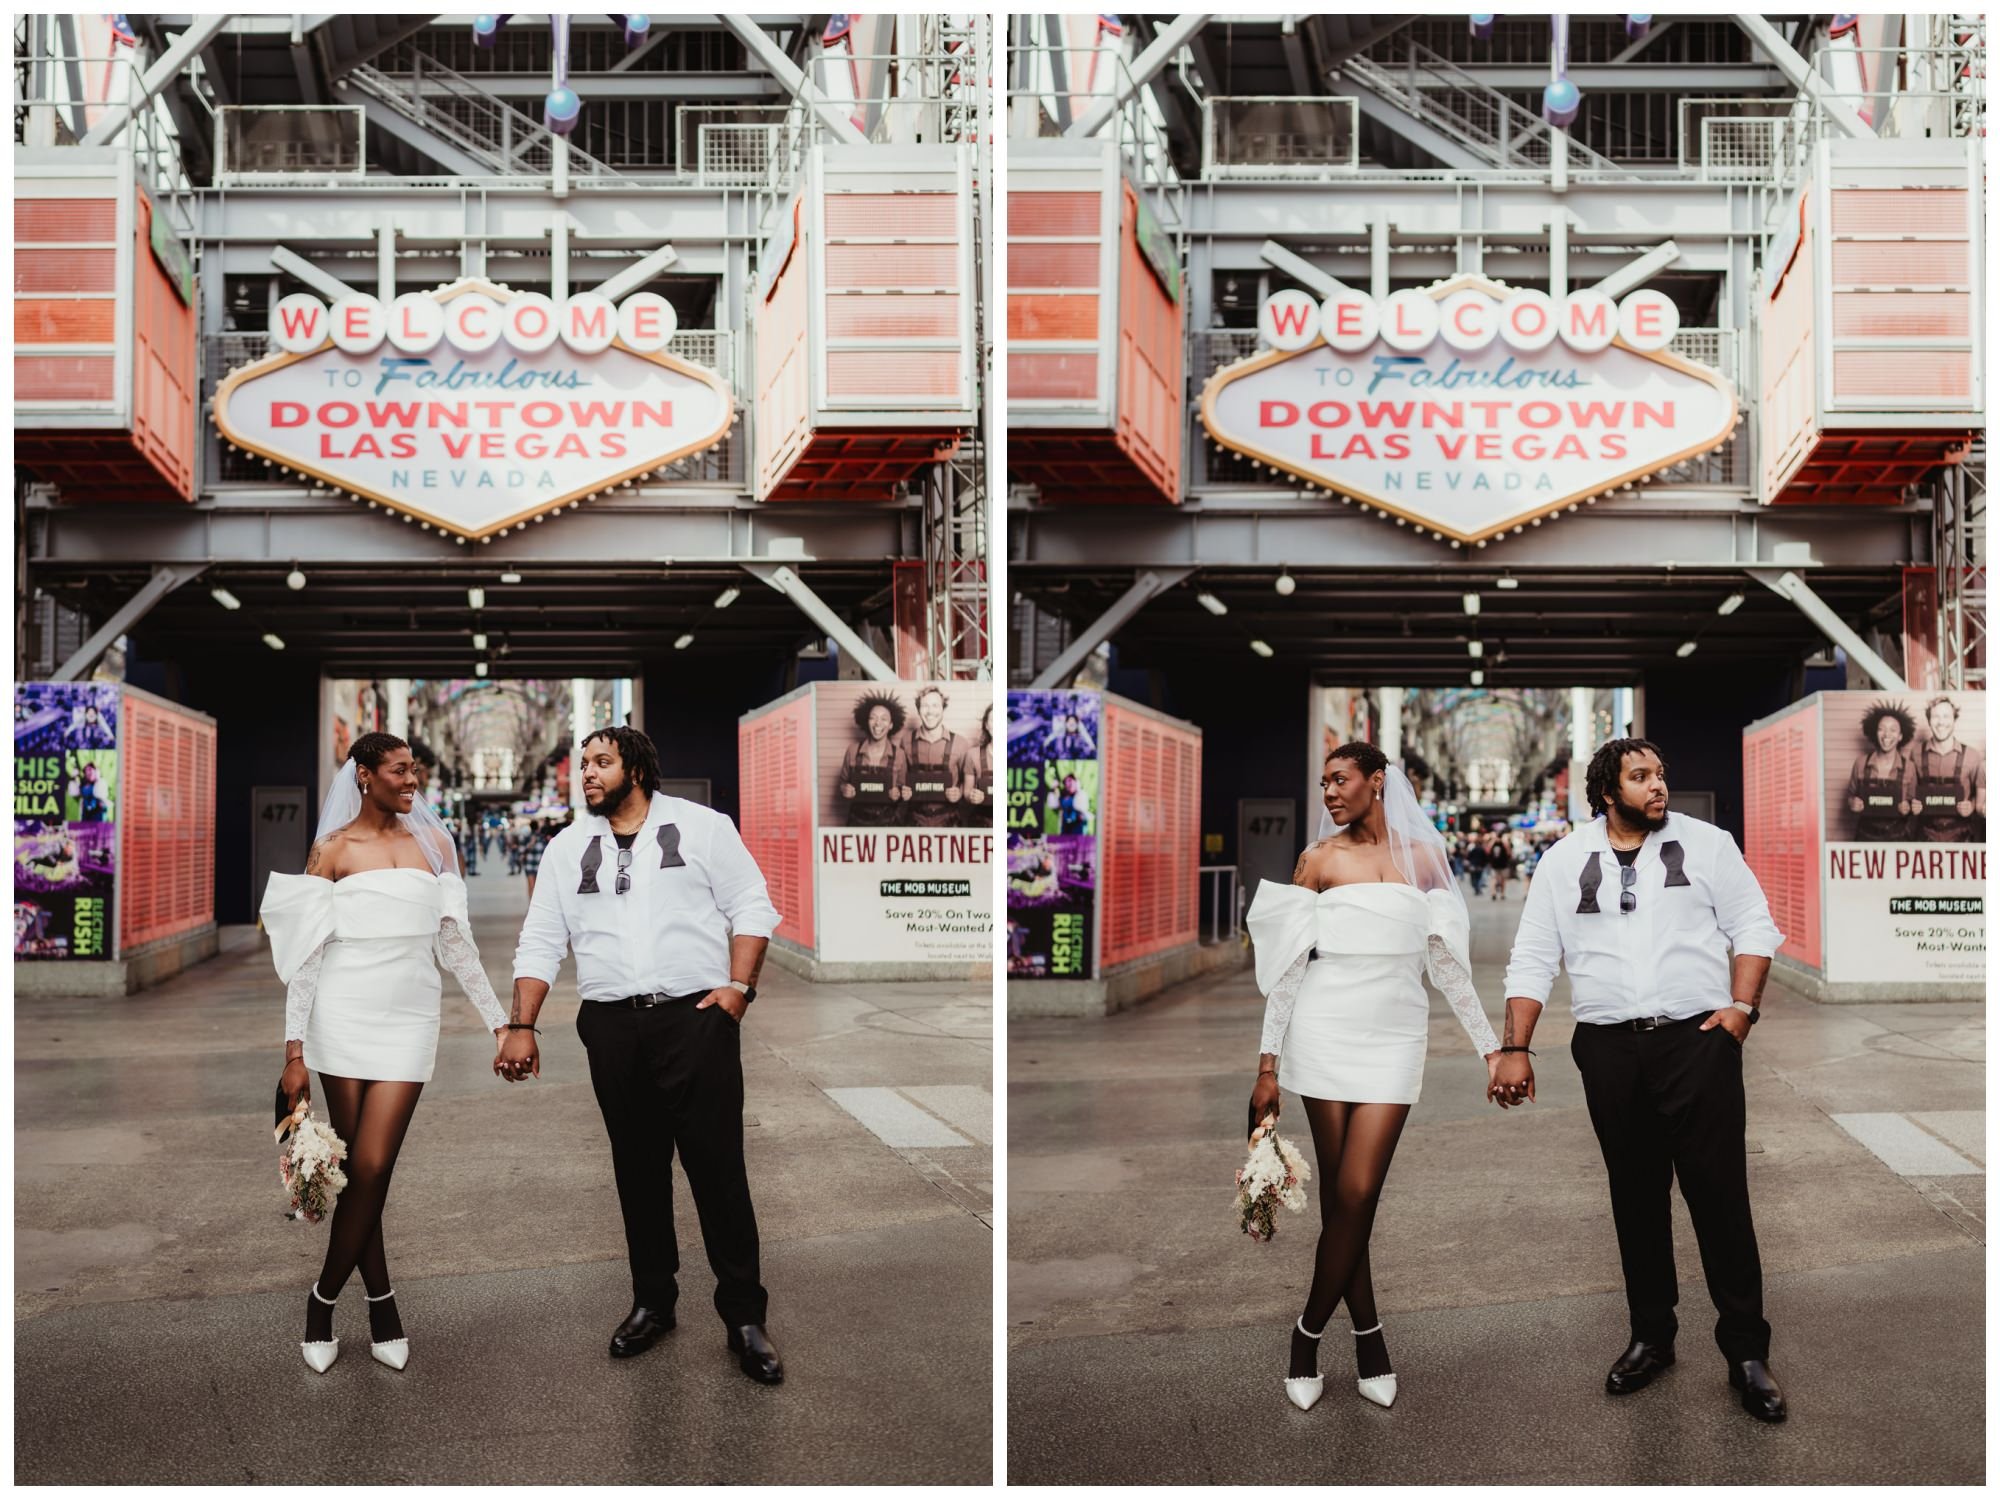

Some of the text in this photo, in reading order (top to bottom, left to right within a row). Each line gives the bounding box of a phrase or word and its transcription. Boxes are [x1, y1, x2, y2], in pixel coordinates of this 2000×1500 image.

[279, 304, 662, 340] WELCOME
[1269, 302, 1663, 338] WELCOME
[323, 357, 592, 396] TO Fabulous
[1314, 356, 1592, 396] TO Fabulous
[270, 401, 673, 428] DOWNTOWN
[1259, 400, 1676, 428] DOWNTOWN
[319, 433, 628, 459] LAS VEGAS
[1309, 433, 1628, 460] LAS VEGAS
[392, 469, 556, 489] NEVADA
[1384, 471, 1554, 490] NEVADA
[18, 780, 60, 795] SLOT-
[14, 795, 60, 815] ILLA
[260, 803, 300, 822] 477
[1249, 816, 1289, 836] 477
[823, 834, 877, 864] NEW
[1830, 850, 1886, 880] NEW
[881, 882, 970, 895] THE MOB MUSEUM
[885, 909, 991, 919] Save 20% On Two
[1891, 900, 1982, 913] THE MOB MUSEUM
[74, 897, 92, 955] RUSH
[92, 898, 104, 956] ELECTRIC
[906, 922, 985, 933] Most-Wanted
[1895, 927, 1925, 937] Save
[1928, 927, 1954, 937] 20%
[1958, 927, 1976, 938] On
[1052, 913, 1071, 973] RUSH
[1071, 914, 1084, 974] ELECTRIC
